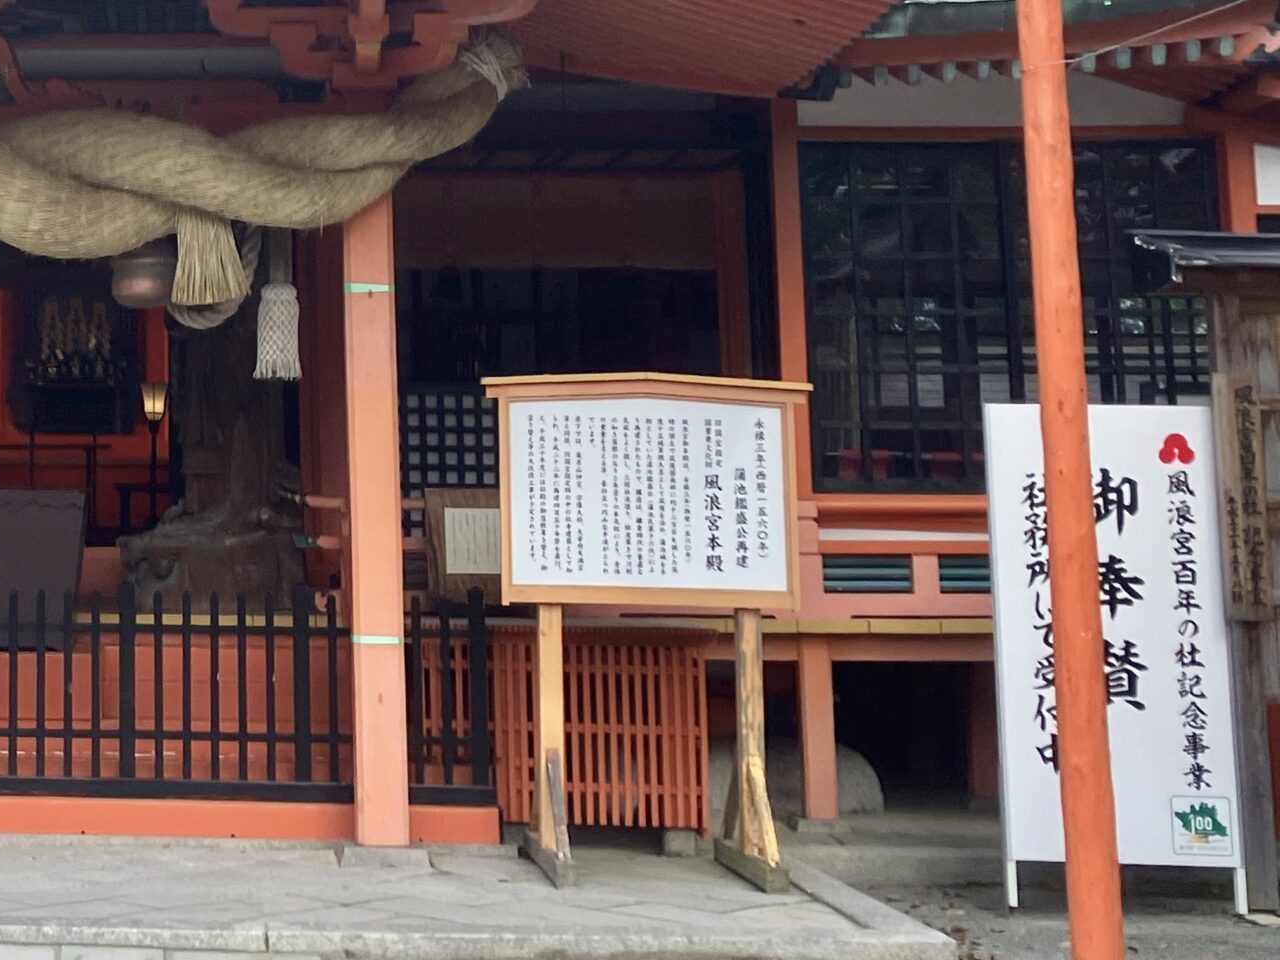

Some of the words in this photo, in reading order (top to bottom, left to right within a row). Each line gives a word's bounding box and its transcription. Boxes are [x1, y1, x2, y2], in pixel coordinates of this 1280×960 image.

[704, 474, 724, 572] 風浪宮本殿
[1168, 471, 1211, 790] 風浪宮百年の杜記念事業
